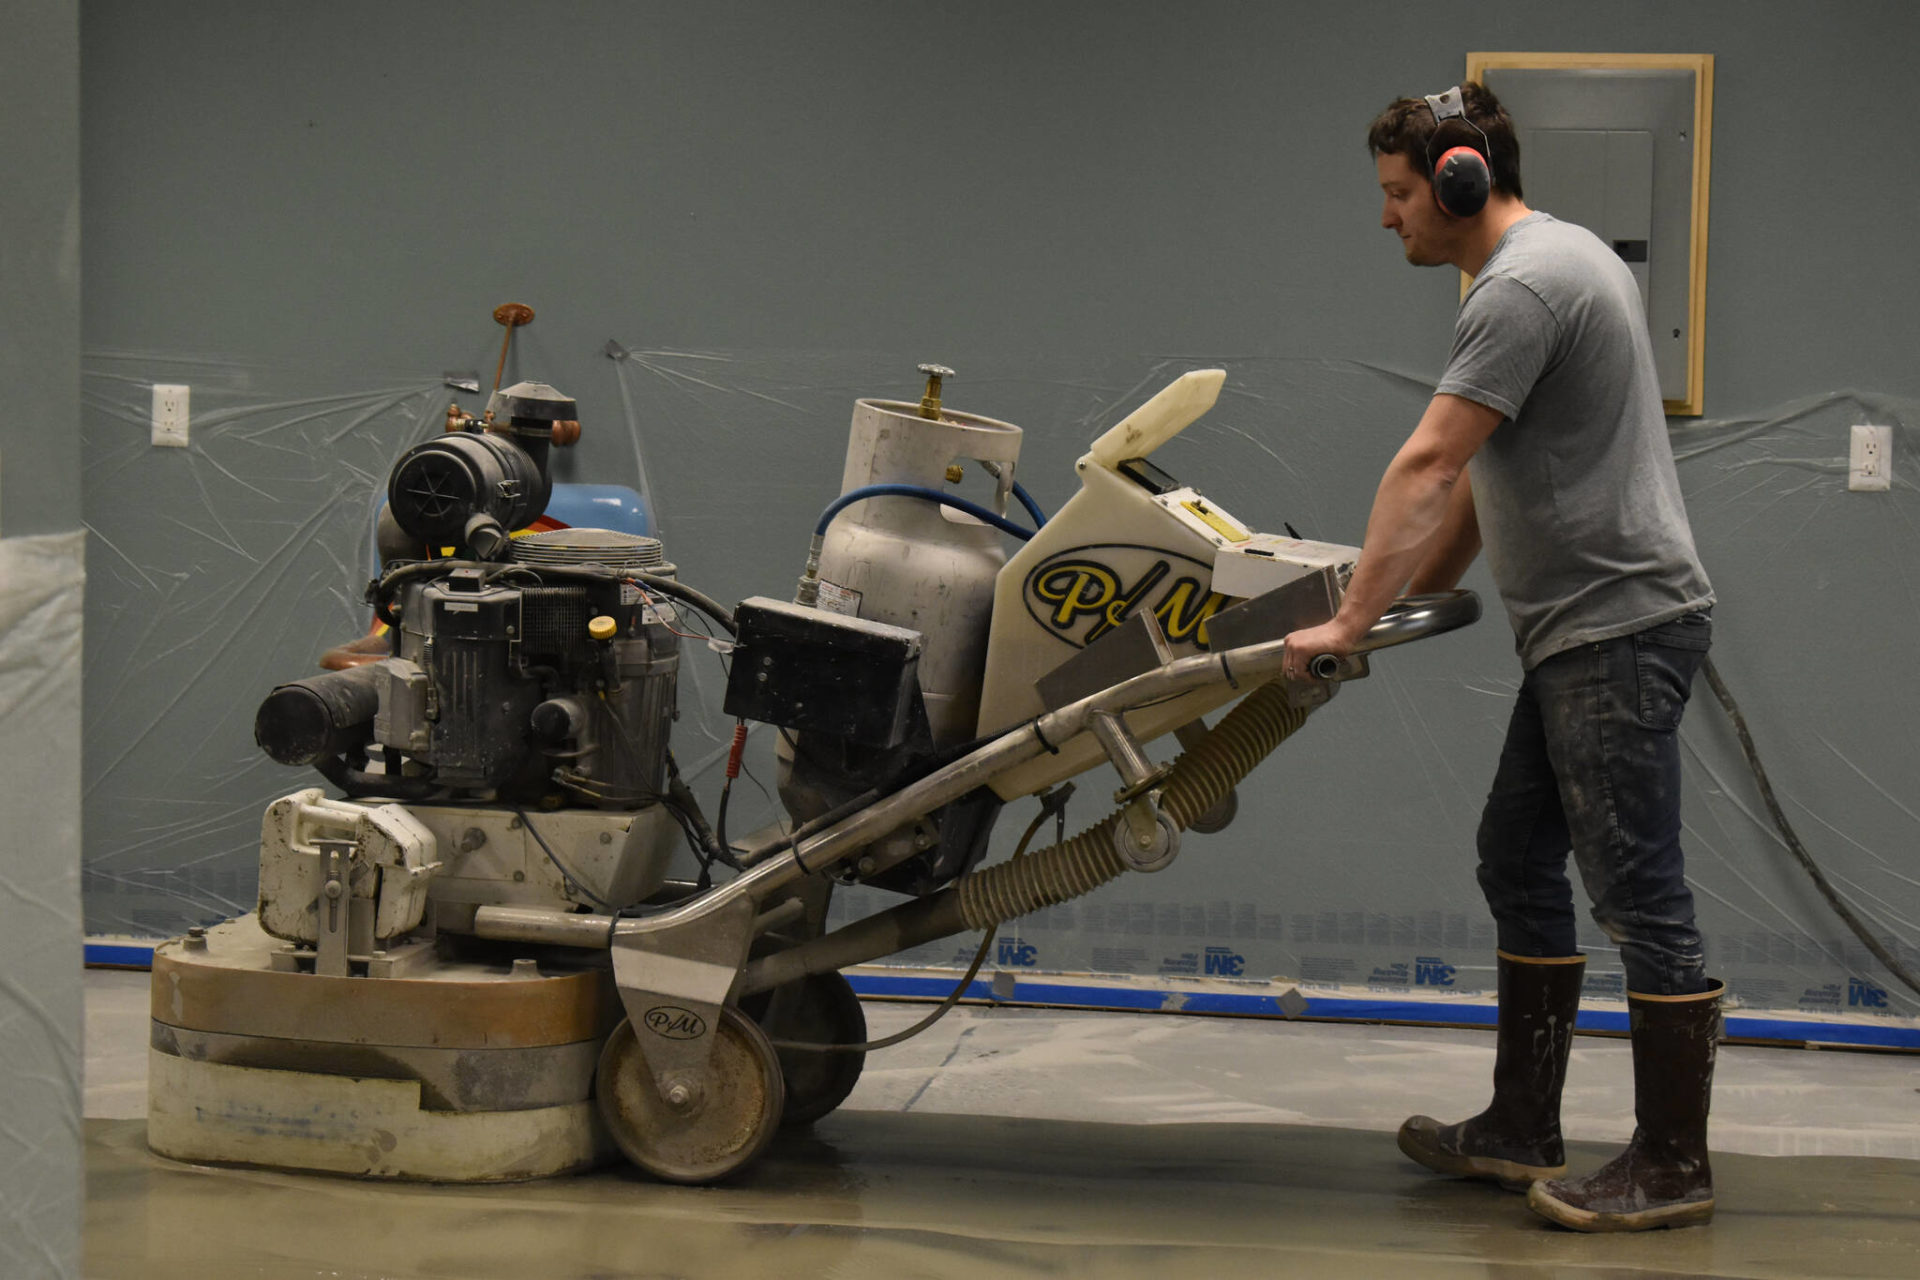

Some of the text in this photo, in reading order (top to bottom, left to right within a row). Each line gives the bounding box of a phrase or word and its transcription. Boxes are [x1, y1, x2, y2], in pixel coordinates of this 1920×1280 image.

[998, 945, 1037, 967] 3M
[1205, 955, 1245, 976] 3M
[1415, 965, 1455, 987] 3M
[1848, 985, 1888, 1009] 3M
